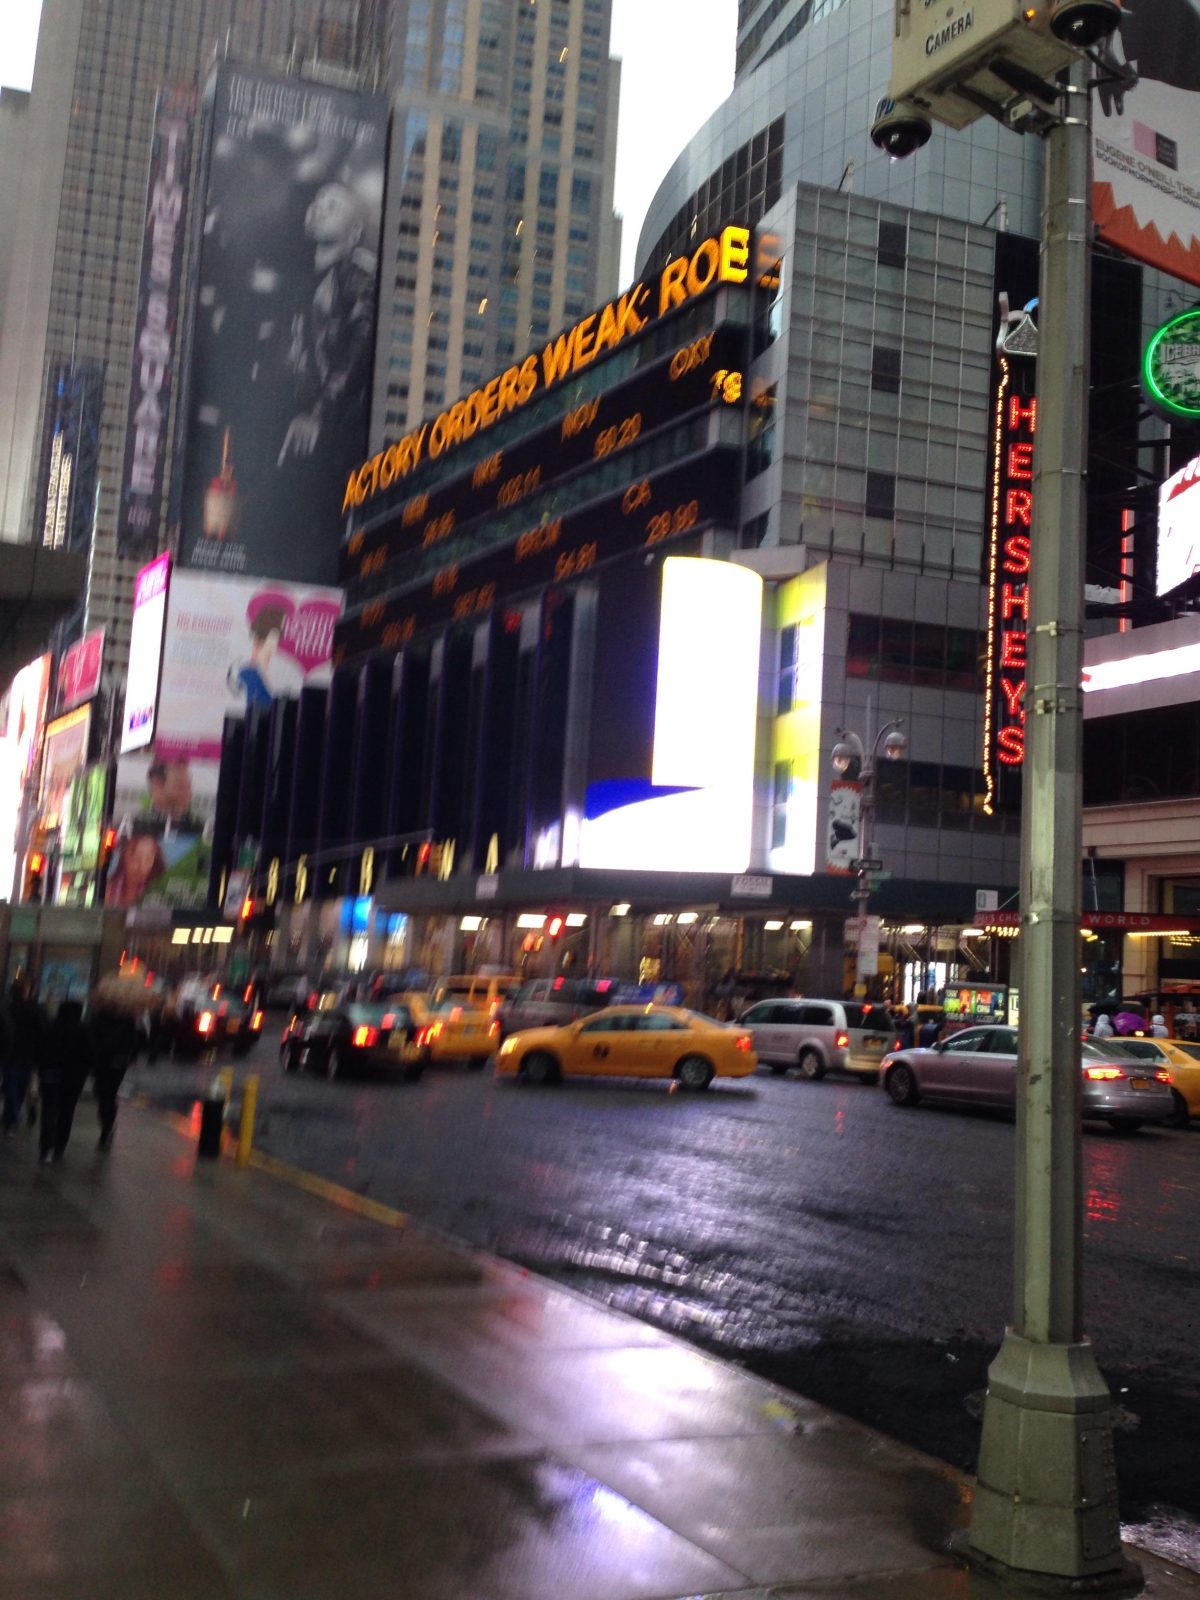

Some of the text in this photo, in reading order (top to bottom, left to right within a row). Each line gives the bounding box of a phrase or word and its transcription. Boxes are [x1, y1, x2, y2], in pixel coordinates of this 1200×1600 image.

[926, 12, 973, 56] CAMERA
[429, 354, 538, 460] ORDERS
[658, 226, 750, 320] ROE
[997, 394, 1038, 765] HERSHEY'S
[1088, 914, 1150, 926] WORLD
